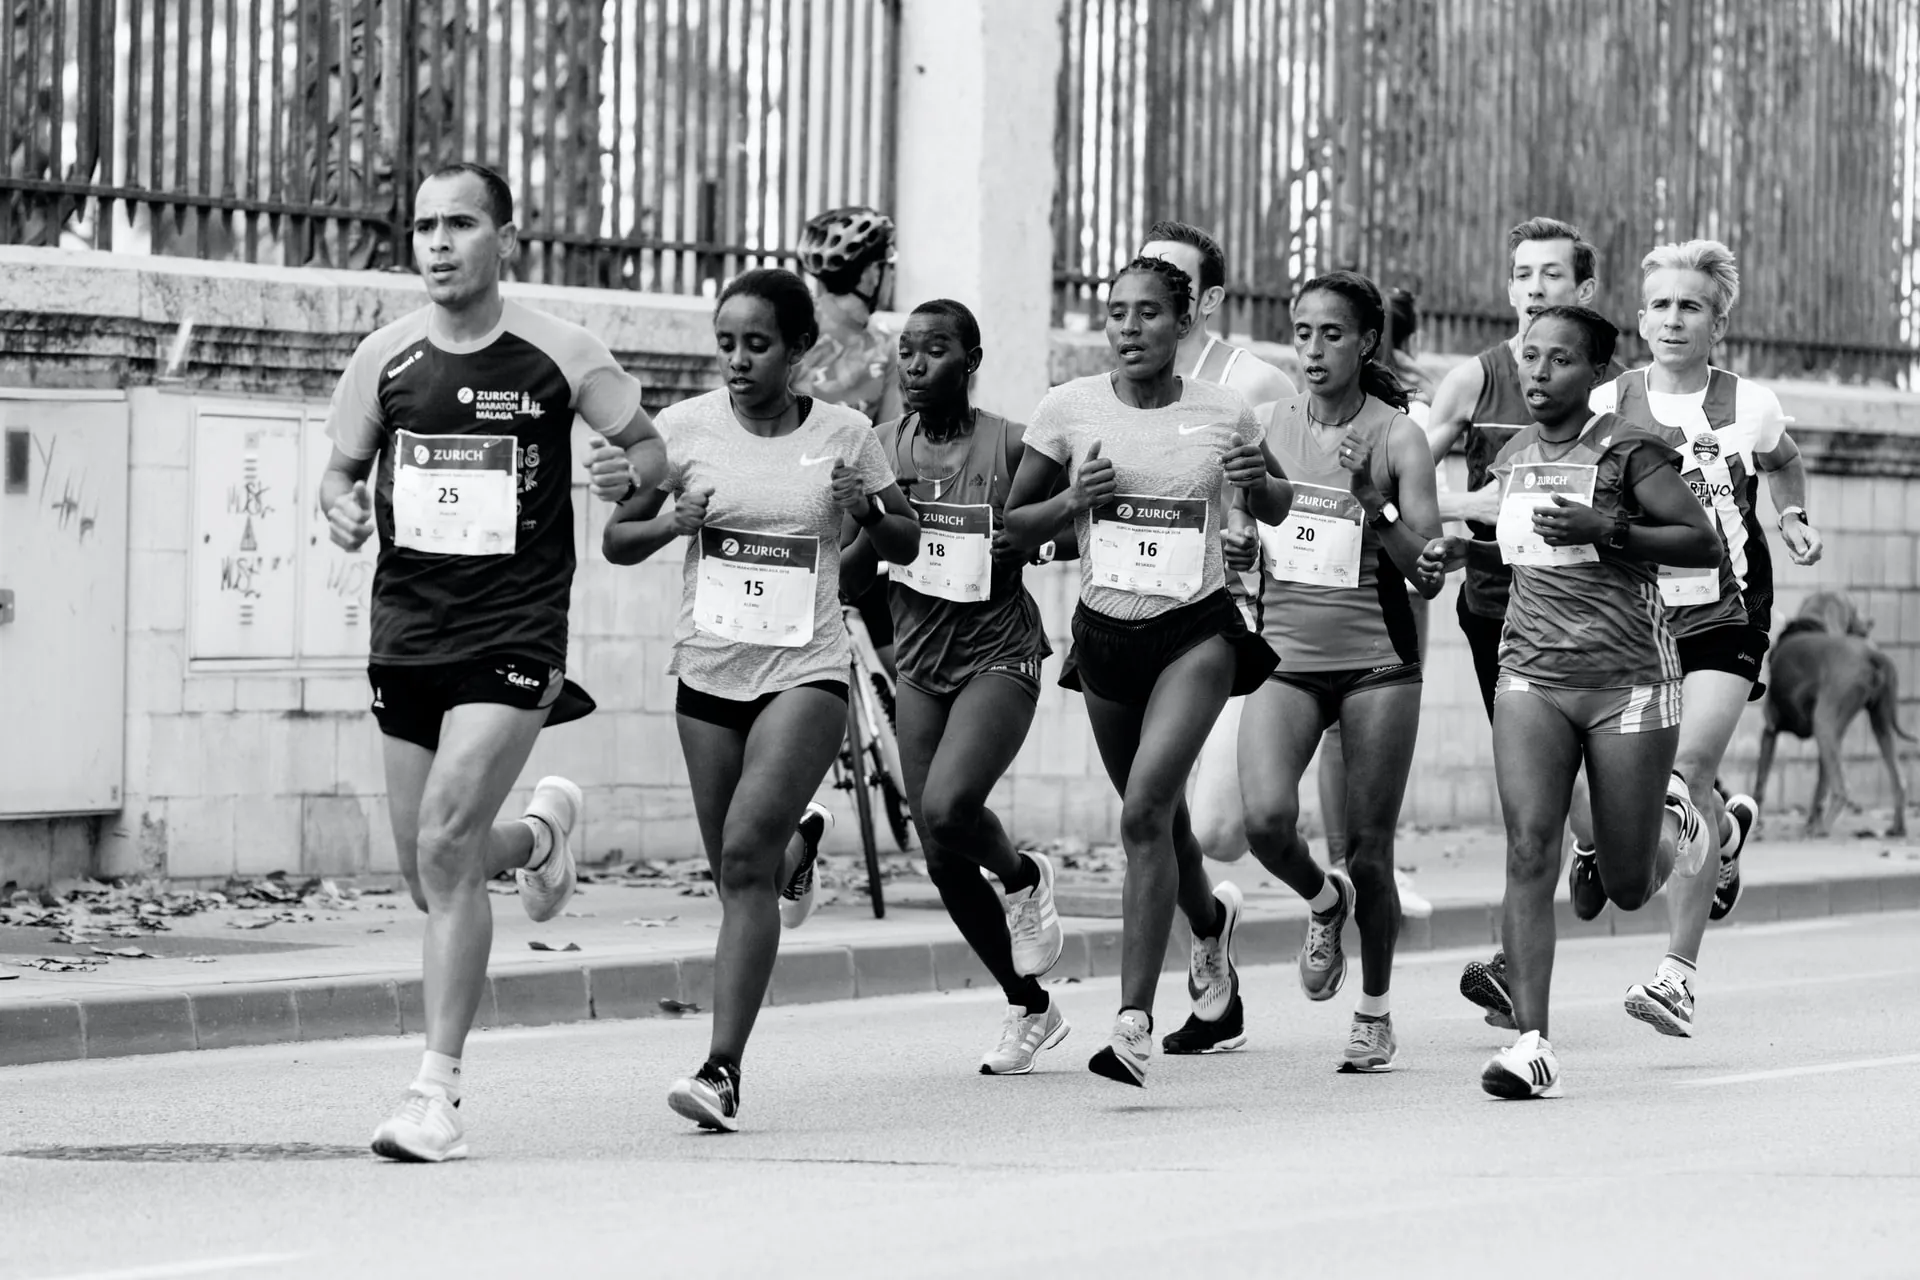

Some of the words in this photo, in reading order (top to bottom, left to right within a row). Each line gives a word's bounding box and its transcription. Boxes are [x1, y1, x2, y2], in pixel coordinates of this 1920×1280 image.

[476, 391, 519, 401] ZURICH
[476, 401, 518, 410] MARATÓN
[476, 410, 513, 420] MÁLAGA
[433, 449, 484, 461] ZURICH
[1536, 475, 1568, 486] ZURICH
[438, 487, 459, 504] 25
[1690, 482, 1731, 496] RTIVO
[1297, 494, 1338, 510] ZURICH
[923, 513, 964, 526] ZURICH
[1137, 508, 1180, 520] ZURICH
[1296, 526, 1315, 542] 20
[743, 544, 790, 558] ZURICH
[927, 542, 945, 557] 18
[1138, 541, 1158, 557] 16
[744, 580, 764, 596] 15
